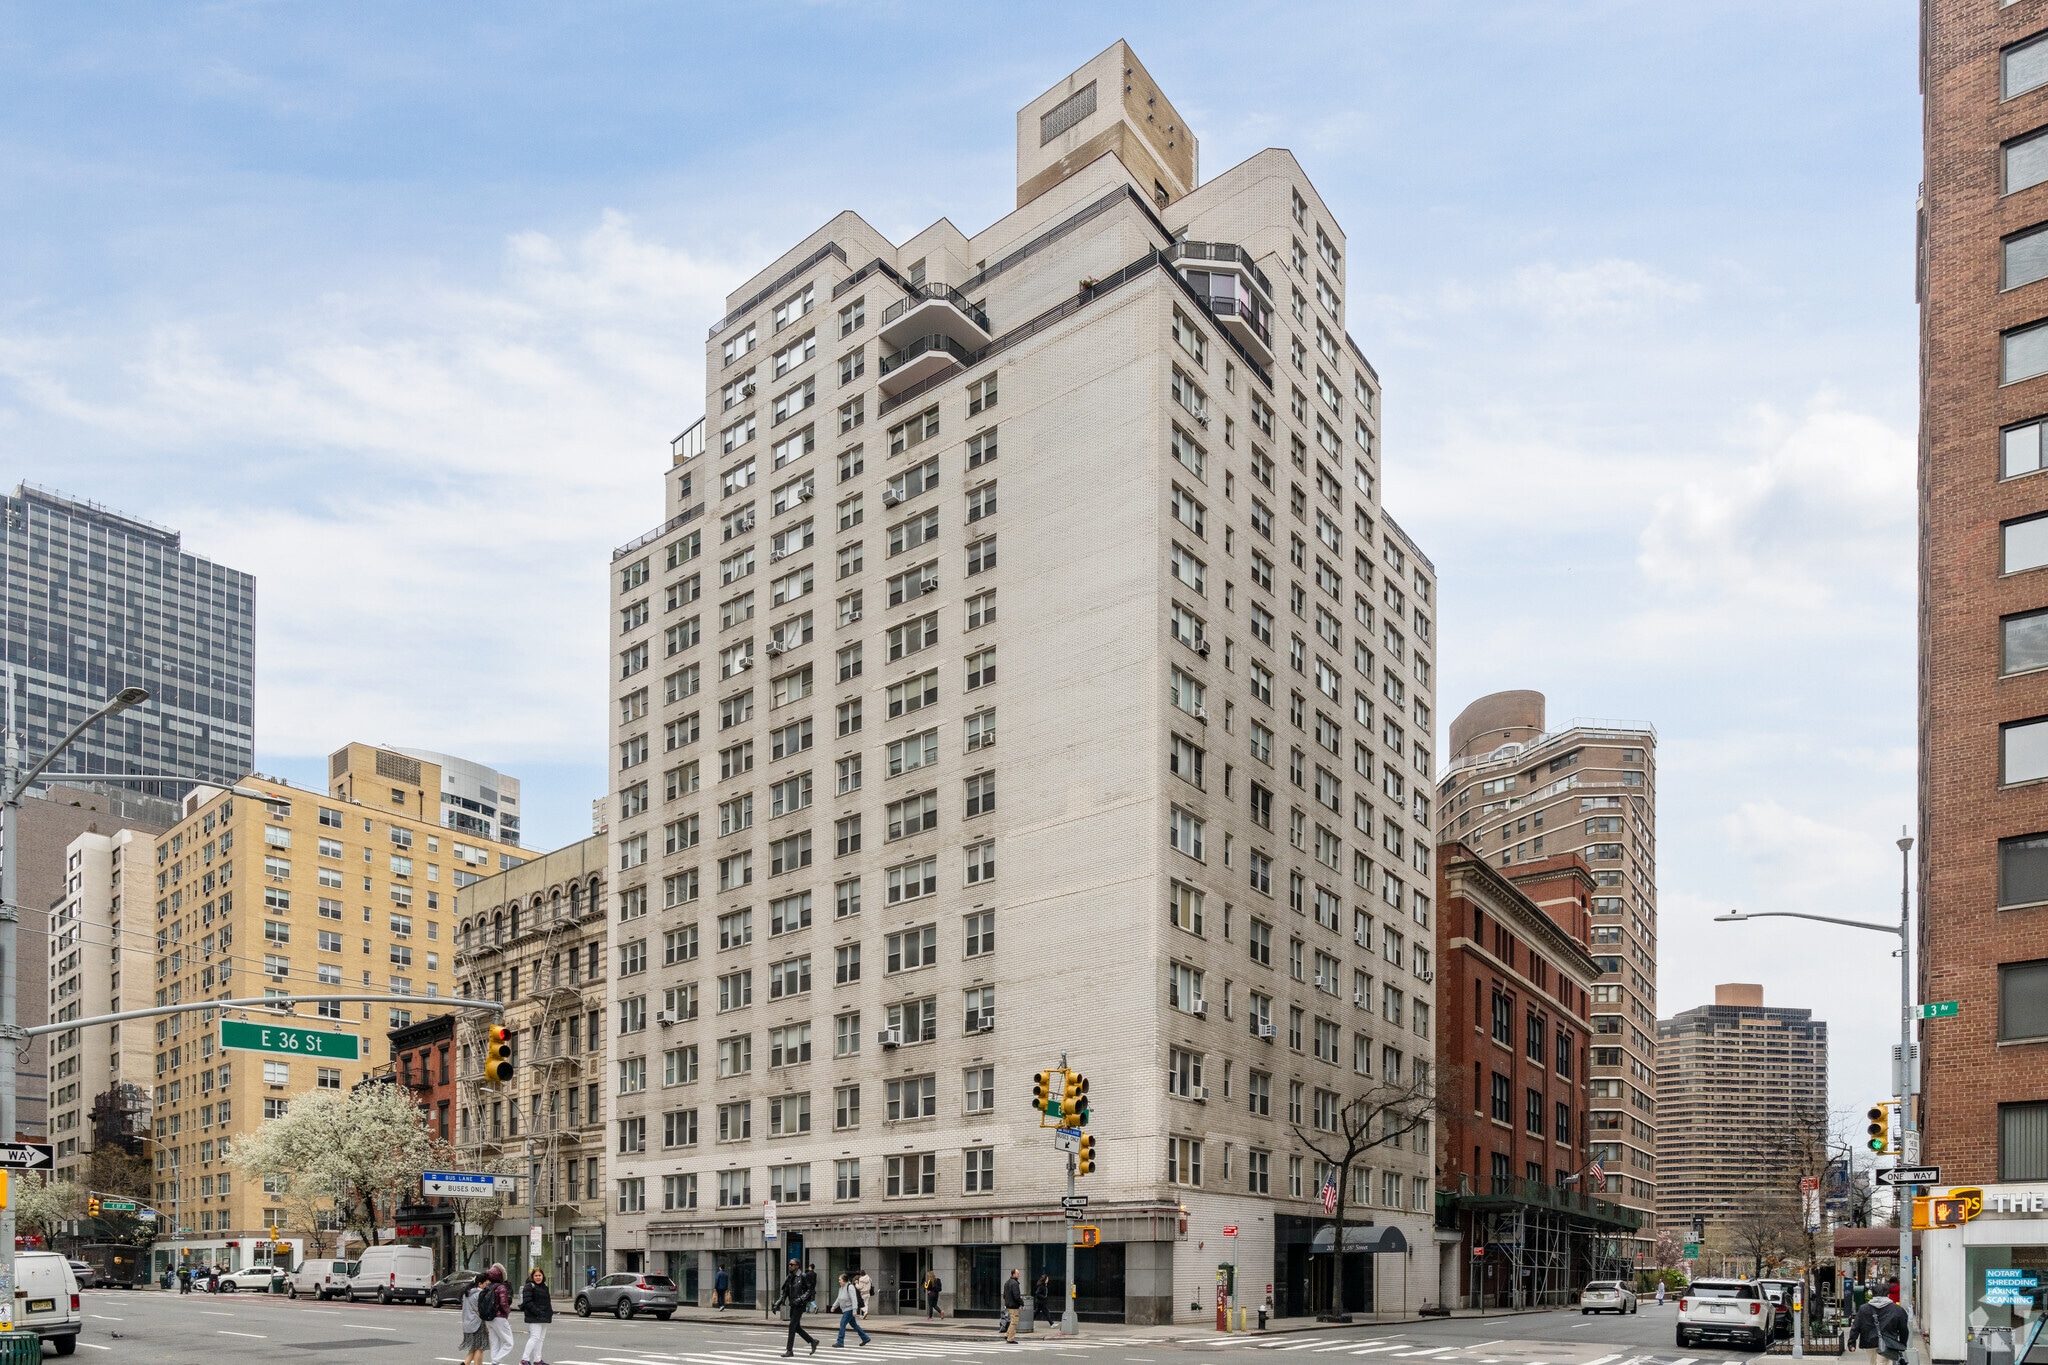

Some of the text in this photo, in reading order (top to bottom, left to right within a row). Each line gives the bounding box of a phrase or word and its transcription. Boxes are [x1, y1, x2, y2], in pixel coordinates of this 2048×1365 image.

[1930, 1005, 1937, 1016] 3
[261, 1029, 322, 1052] E 36 St
[8, 1150, 36, 1161] WAY
[1887, 1172, 1933, 1181] ONE WAY
[1993, 1192, 2044, 1213] THE
[1958, 1204, 1965, 1220] 3
[1987, 1296, 2033, 1304] SCANNING
